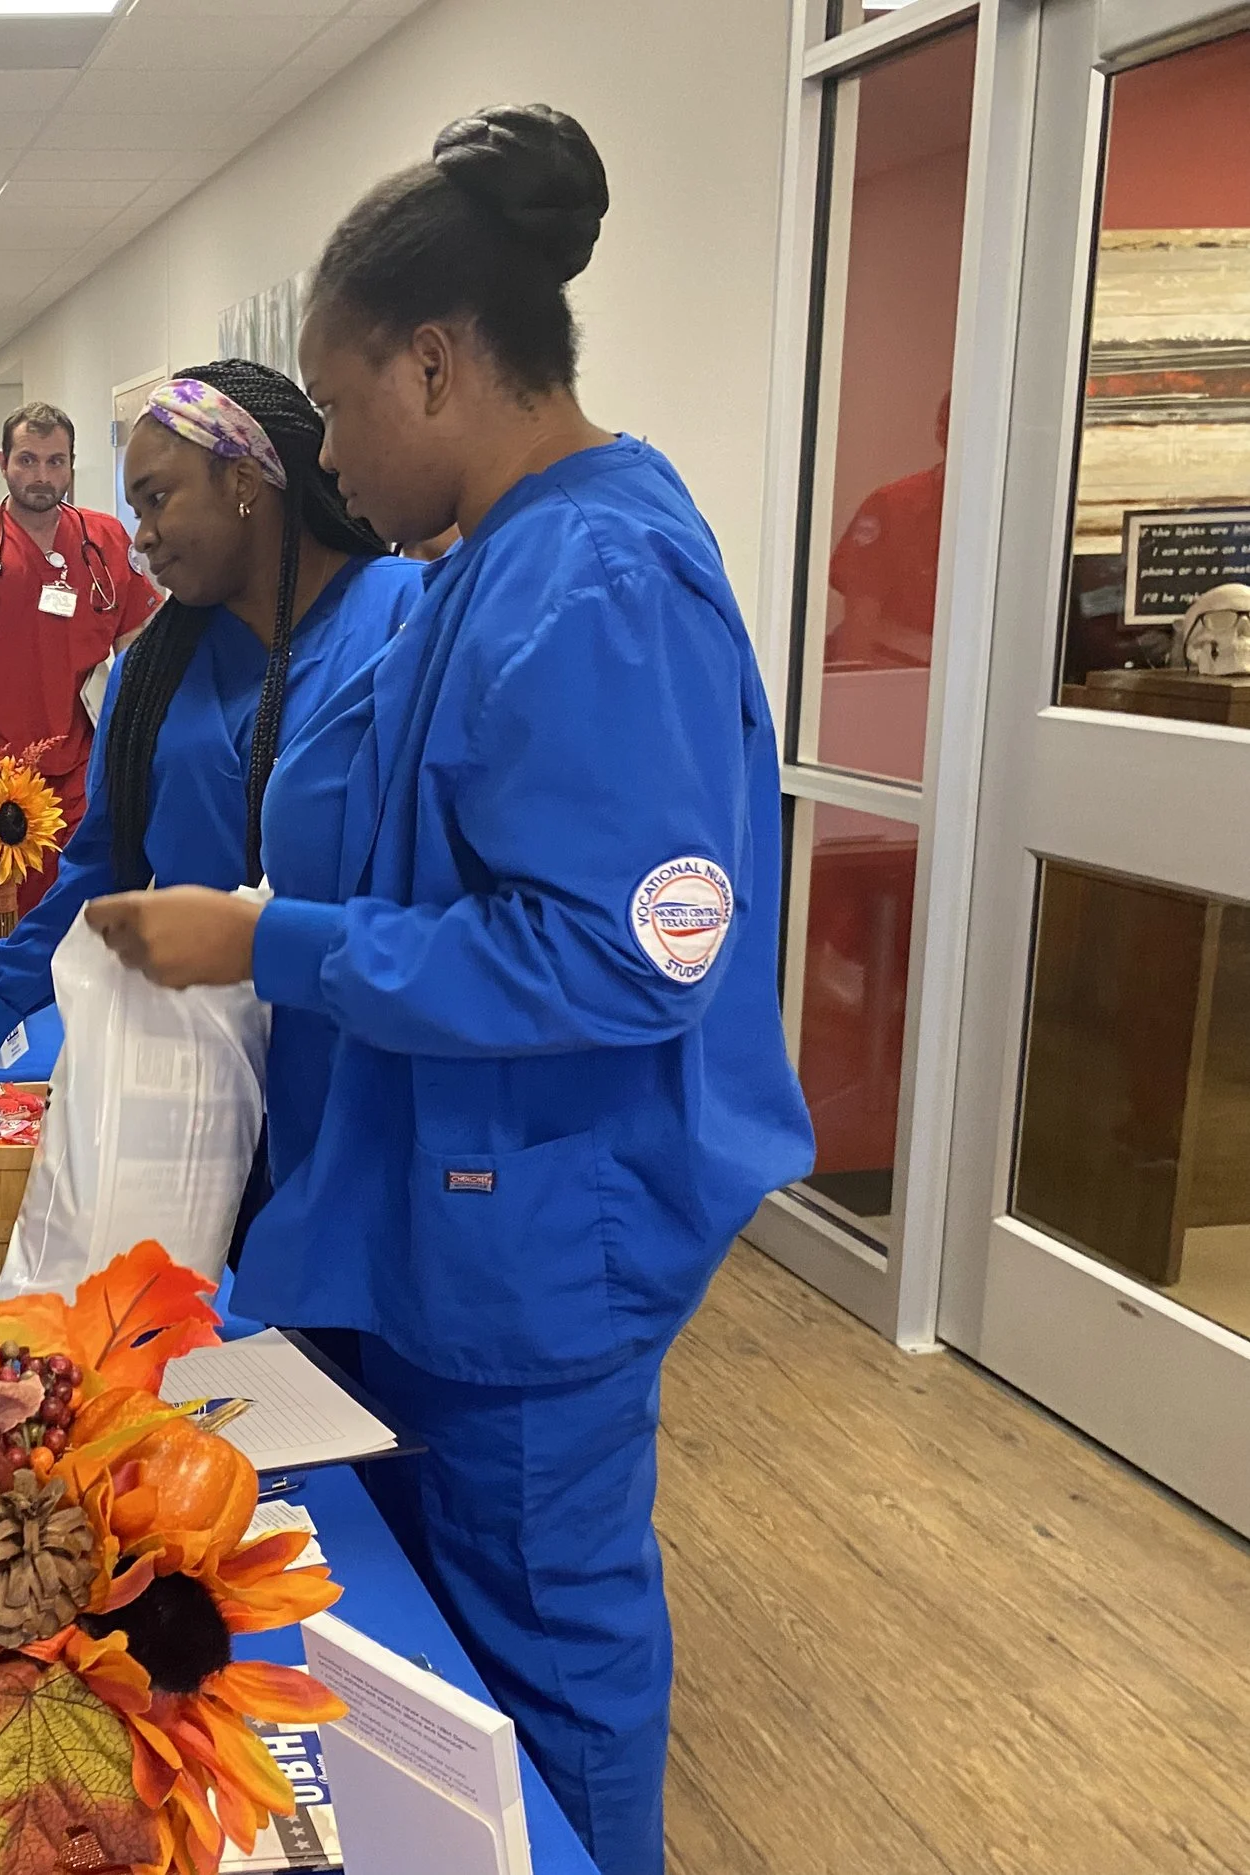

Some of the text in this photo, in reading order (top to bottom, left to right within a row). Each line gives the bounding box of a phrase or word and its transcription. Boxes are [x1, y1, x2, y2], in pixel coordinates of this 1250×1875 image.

[1210, 527, 1229, 535] are
[1161, 548, 1179, 556] am
[1183, 545, 1218, 555] either
[1221, 546, 1236, 555] on
[1140, 567, 1174, 579] phone
[1178, 567, 1192, 576] or
[1195, 566, 1207, 575] in
[1211, 566, 1219, 575] a
[1162, 592, 1175, 603] be
[637, 862, 702, 927] VOCATIONAL
[655, 908, 723, 918] NORTH CENTRAL
[660, 918, 690, 927] TEXAS
[665, 957, 710, 977] STUDENT
